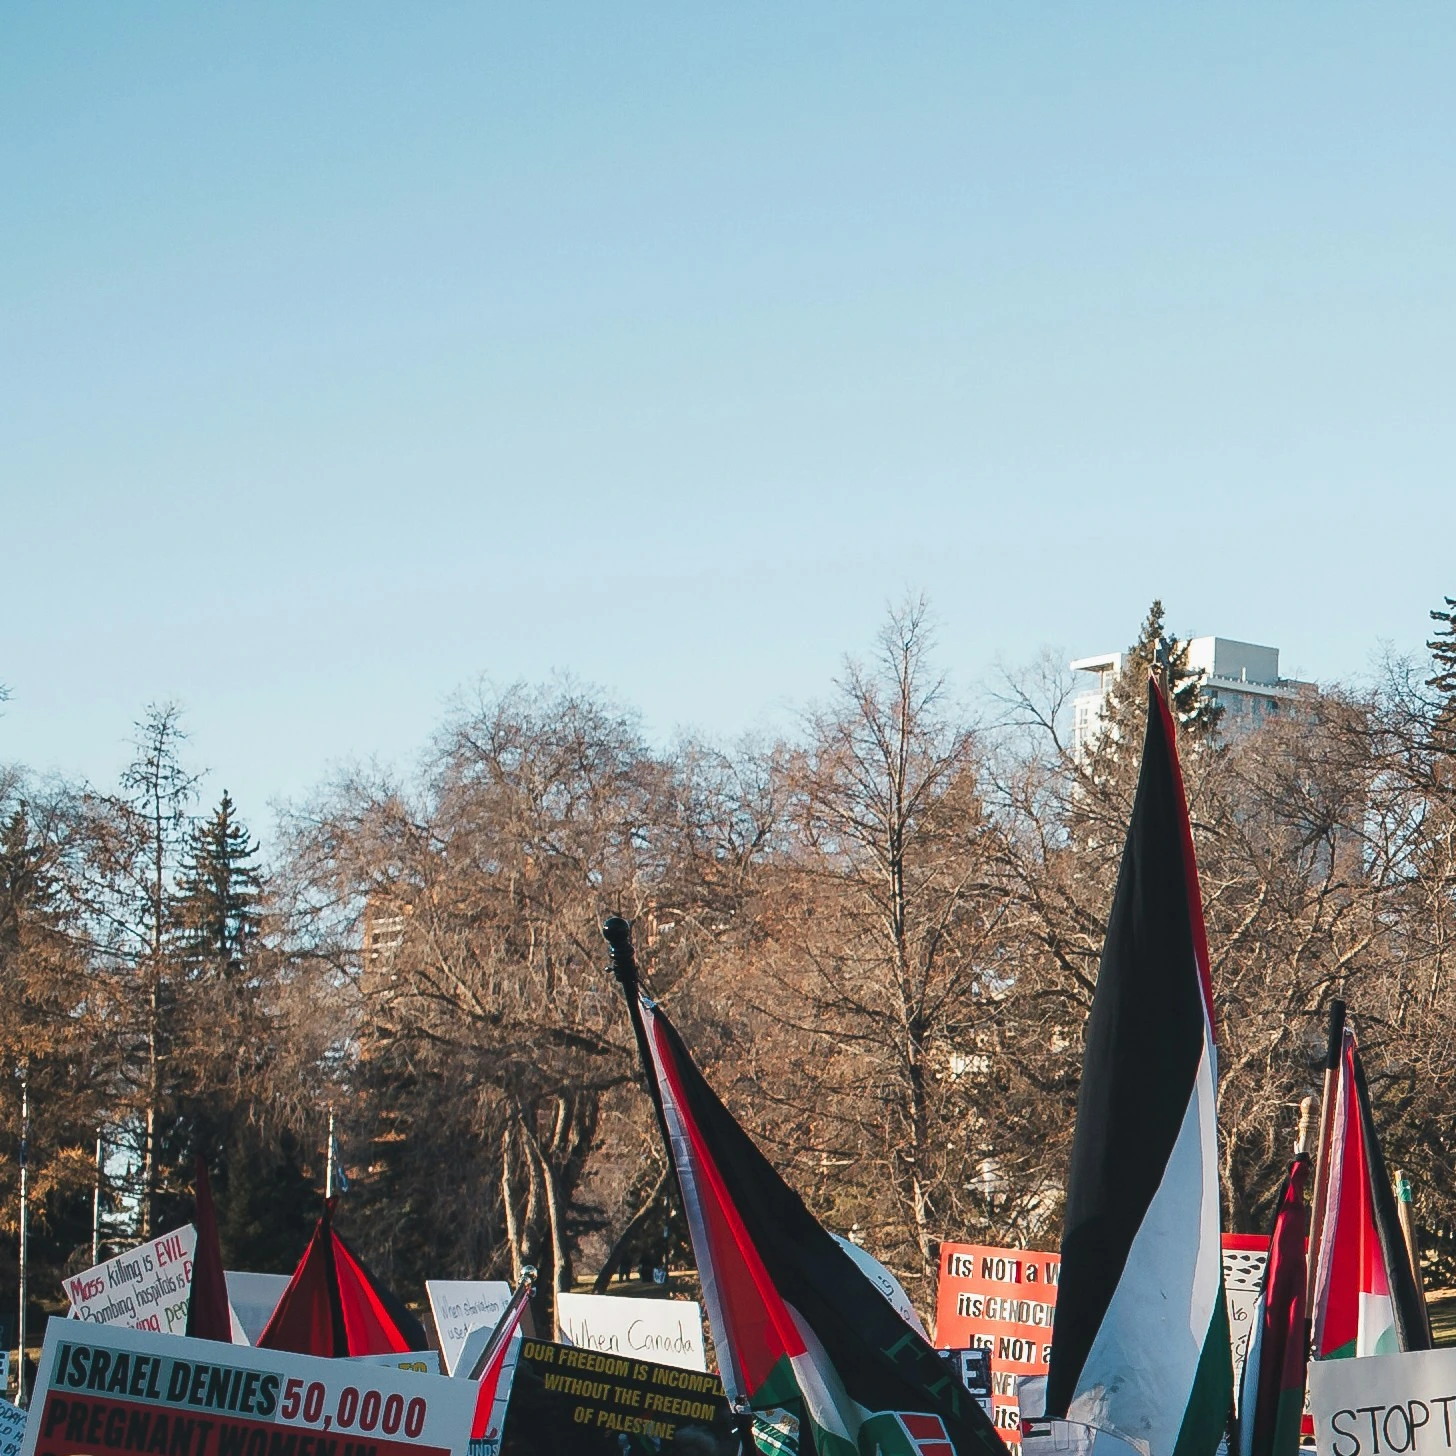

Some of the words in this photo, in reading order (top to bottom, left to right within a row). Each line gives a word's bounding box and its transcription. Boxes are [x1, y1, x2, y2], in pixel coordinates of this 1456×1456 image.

[69, 1275, 105, 1306] Mass
[106, 1257, 144, 1289] killing
[141, 1254, 153, 1273] is
[154, 1234, 188, 1268] EVIL
[948, 1253, 974, 1278] Its
[981, 1256, 1022, 1284] NOT
[1025, 1263, 1038, 1283] a
[80, 1294, 137, 1324] Bombing
[132, 1268, 177, 1307] hospitals
[957, 1293, 984, 1318] its
[569, 1318, 620, 1353] When
[628, 1318, 695, 1353] Canada
[999, 1336, 1037, 1363] NOT
[523, 1341, 555, 1364] OUR
[559, 1349, 630, 1379] FREEDOM
[633, 1364, 649, 1381] IS
[55, 1343, 162, 1400] ISRAEL
[166, 1360, 281, 1417] DENIES
[280, 1378, 428, 1439] 50,0000
[544, 1372, 611, 1402] WITHOUT
[614, 1387, 641, 1407] THE
[643, 1393, 716, 1421] FREEDOM
[573, 1405, 594, 1424] OF
[597, 1409, 677, 1441] PALESTINE
[994, 1405, 1019, 1430] its
